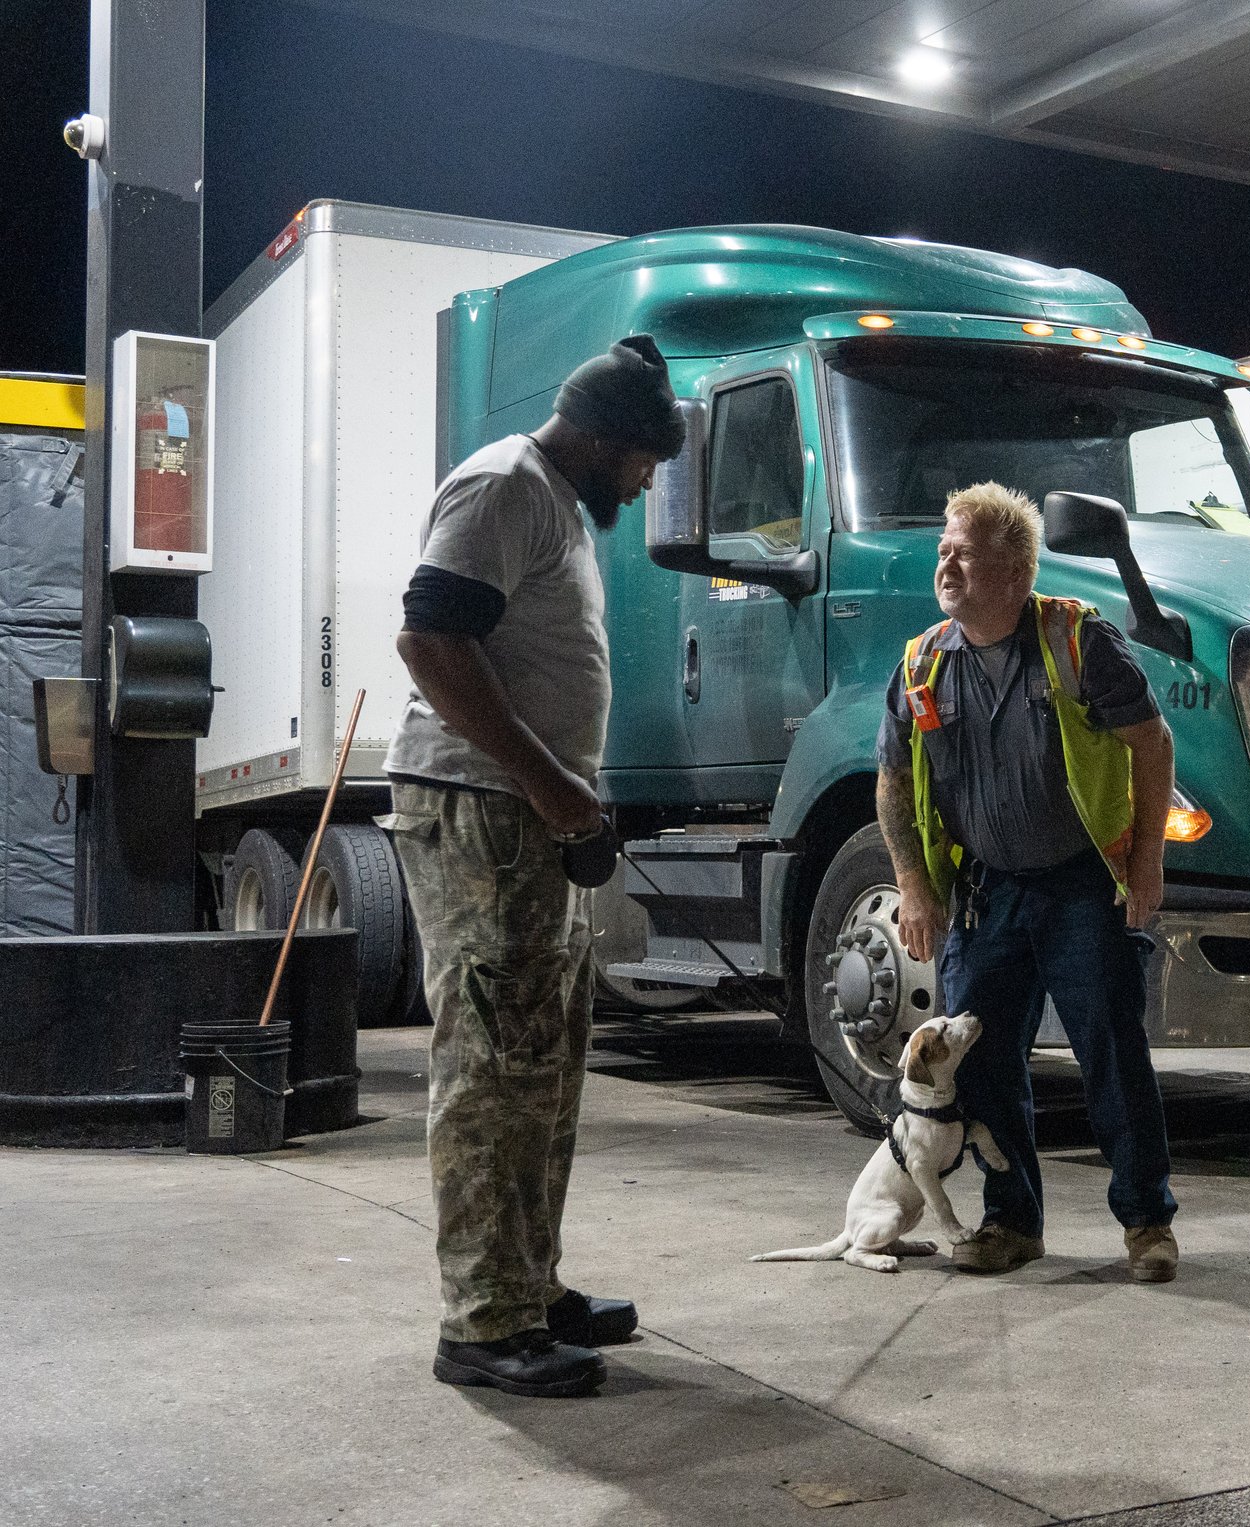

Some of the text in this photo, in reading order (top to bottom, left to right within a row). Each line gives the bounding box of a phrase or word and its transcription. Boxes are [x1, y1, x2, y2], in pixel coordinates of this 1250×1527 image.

[162, 452, 184, 461] FIRE
[719, 585, 749, 602] TRUCKING
[321, 616, 332, 688] 2308
[1165, 681, 1210, 710] 401
